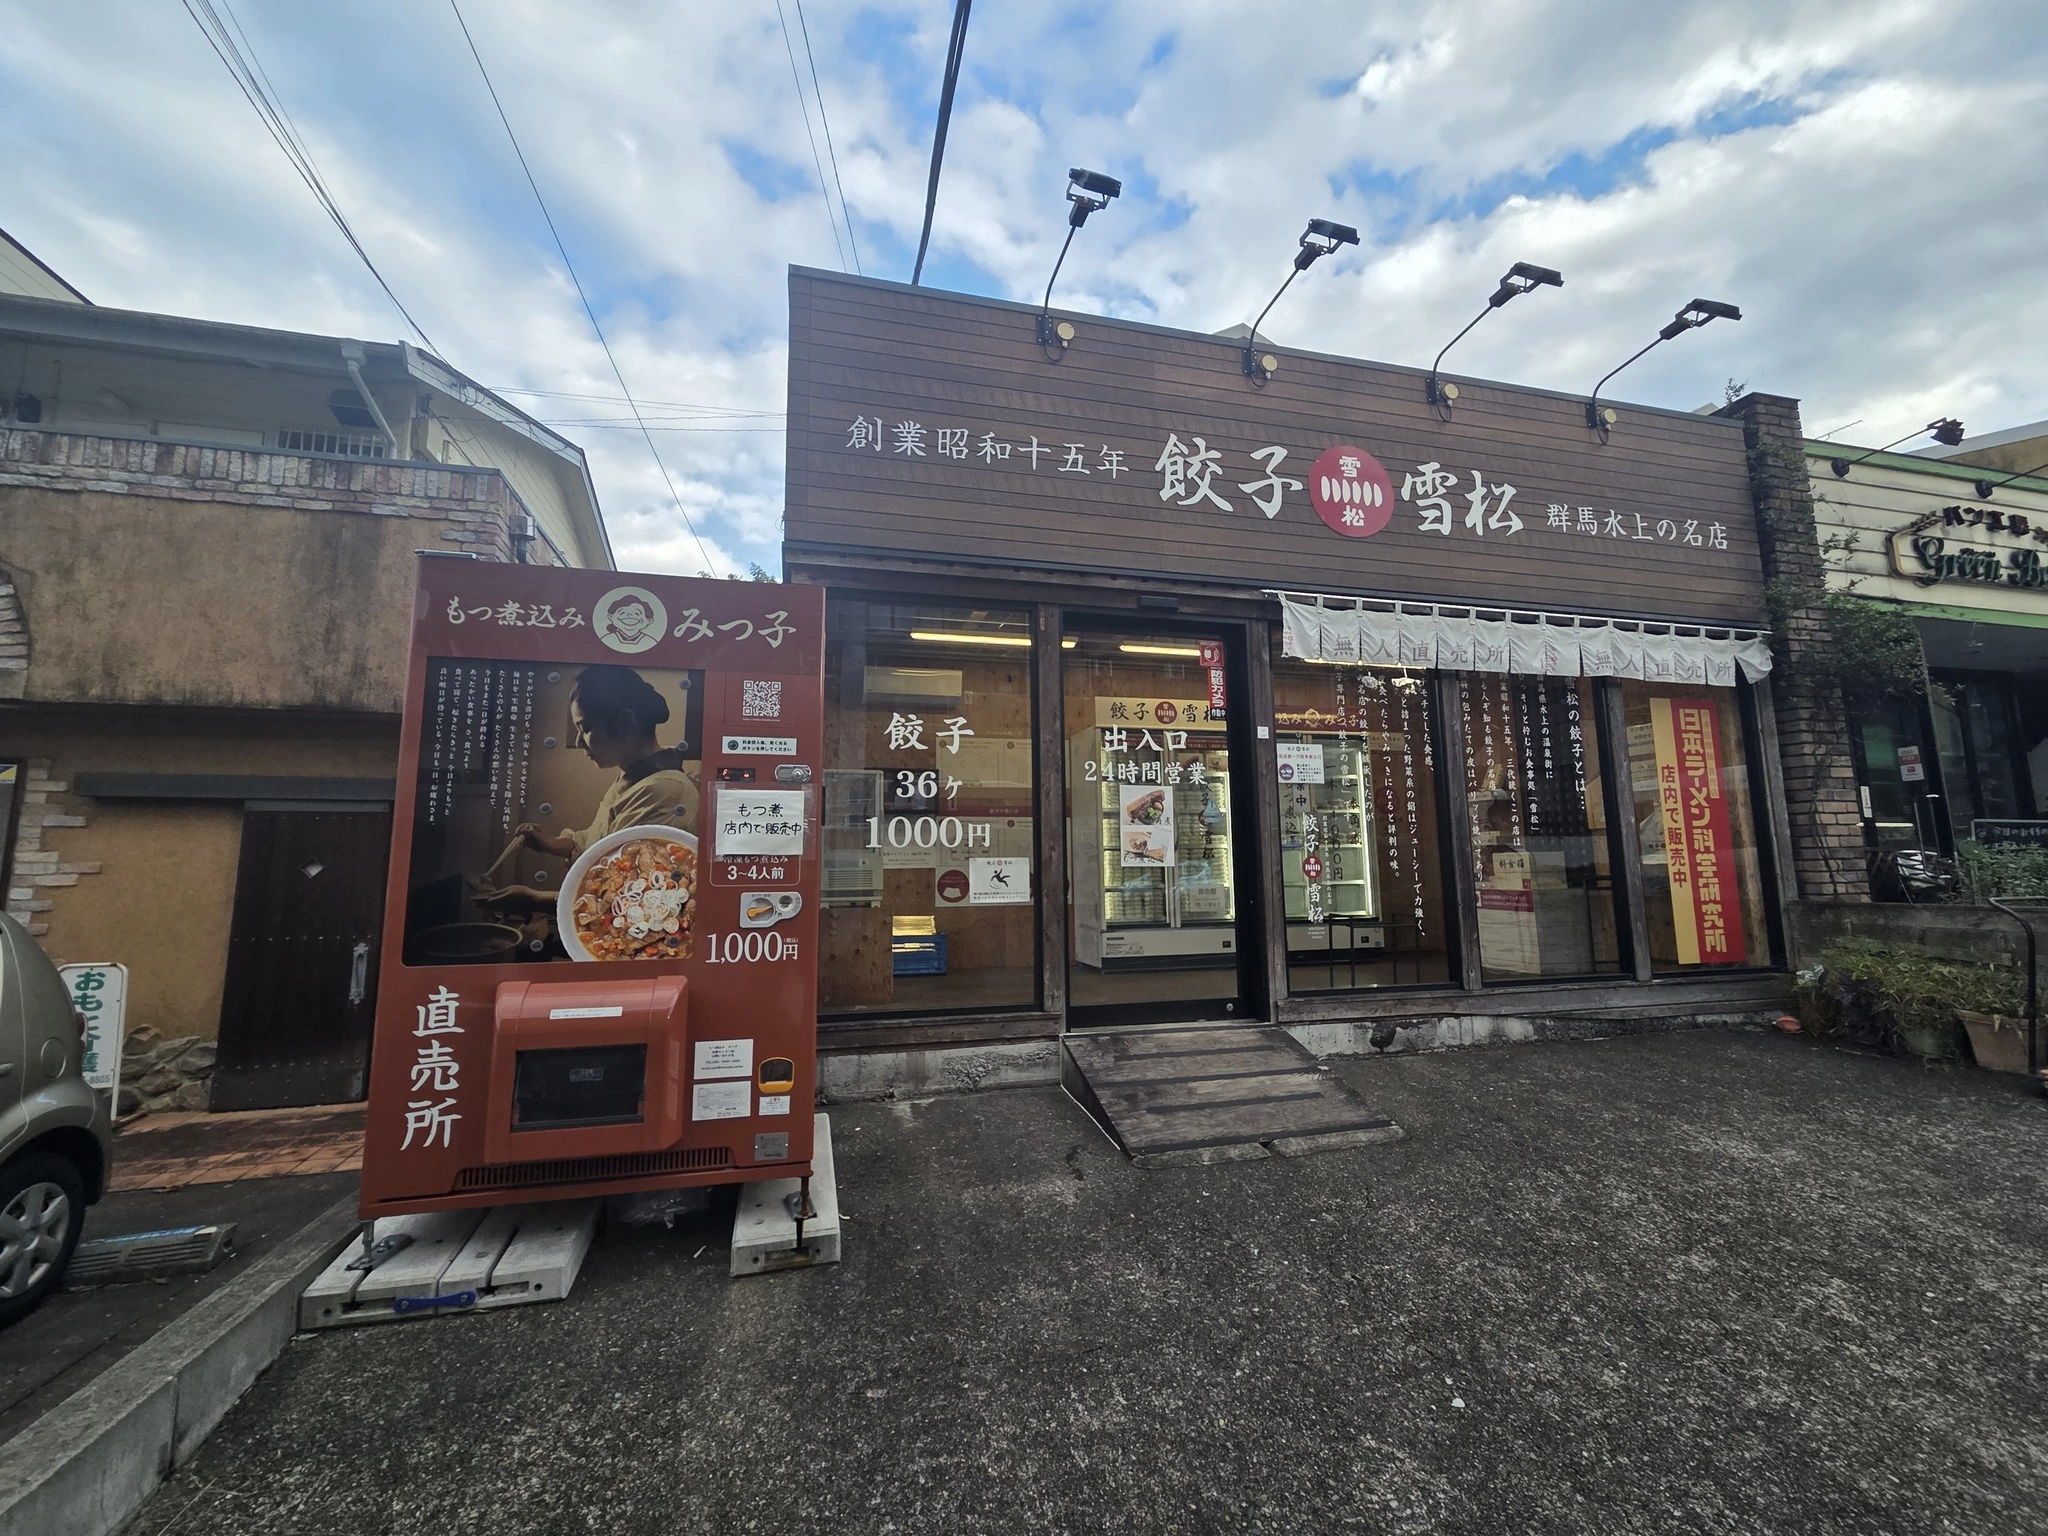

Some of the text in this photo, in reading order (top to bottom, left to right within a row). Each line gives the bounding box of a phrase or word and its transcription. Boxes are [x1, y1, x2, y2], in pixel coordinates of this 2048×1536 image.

[845, 415, 1129, 480] 創業昭和十五年
[1154, 433, 1524, 536] 餃子 雪松
[1339, 456, 1361, 478] 雪
[1341, 506, 1365, 526] 松
[1545, 502, 1731, 553] 群馬水上の名店
[446, 596, 797, 648] もつ煮込み みつ子
[1333, 634, 1505, 665] 無人直売所
[1595, 649, 1732, 679] 無人直売所
[1211, 669, 1224, 707] 防犯カメラ
[1110, 701, 1149, 721] 餃子
[883, 711, 975, 755] 餃子
[1102, 724, 1188, 754] 出入口
[1084, 760, 1208, 785] 24時間営業
[723, 820, 802, 836] 店内で販売中
[738, 803, 784, 818] もつ煮
[1660, 764, 1688, 888] 店内で販売中
[865, 815, 991, 849] 1000円
[1303, 814, 1320, 853] 餃子
[1678, 708, 1728, 953] 日本ラーメン科学研究所
[1308, 883, 1324, 923] 雪松
[400, 985, 465, 1151] 直売所
